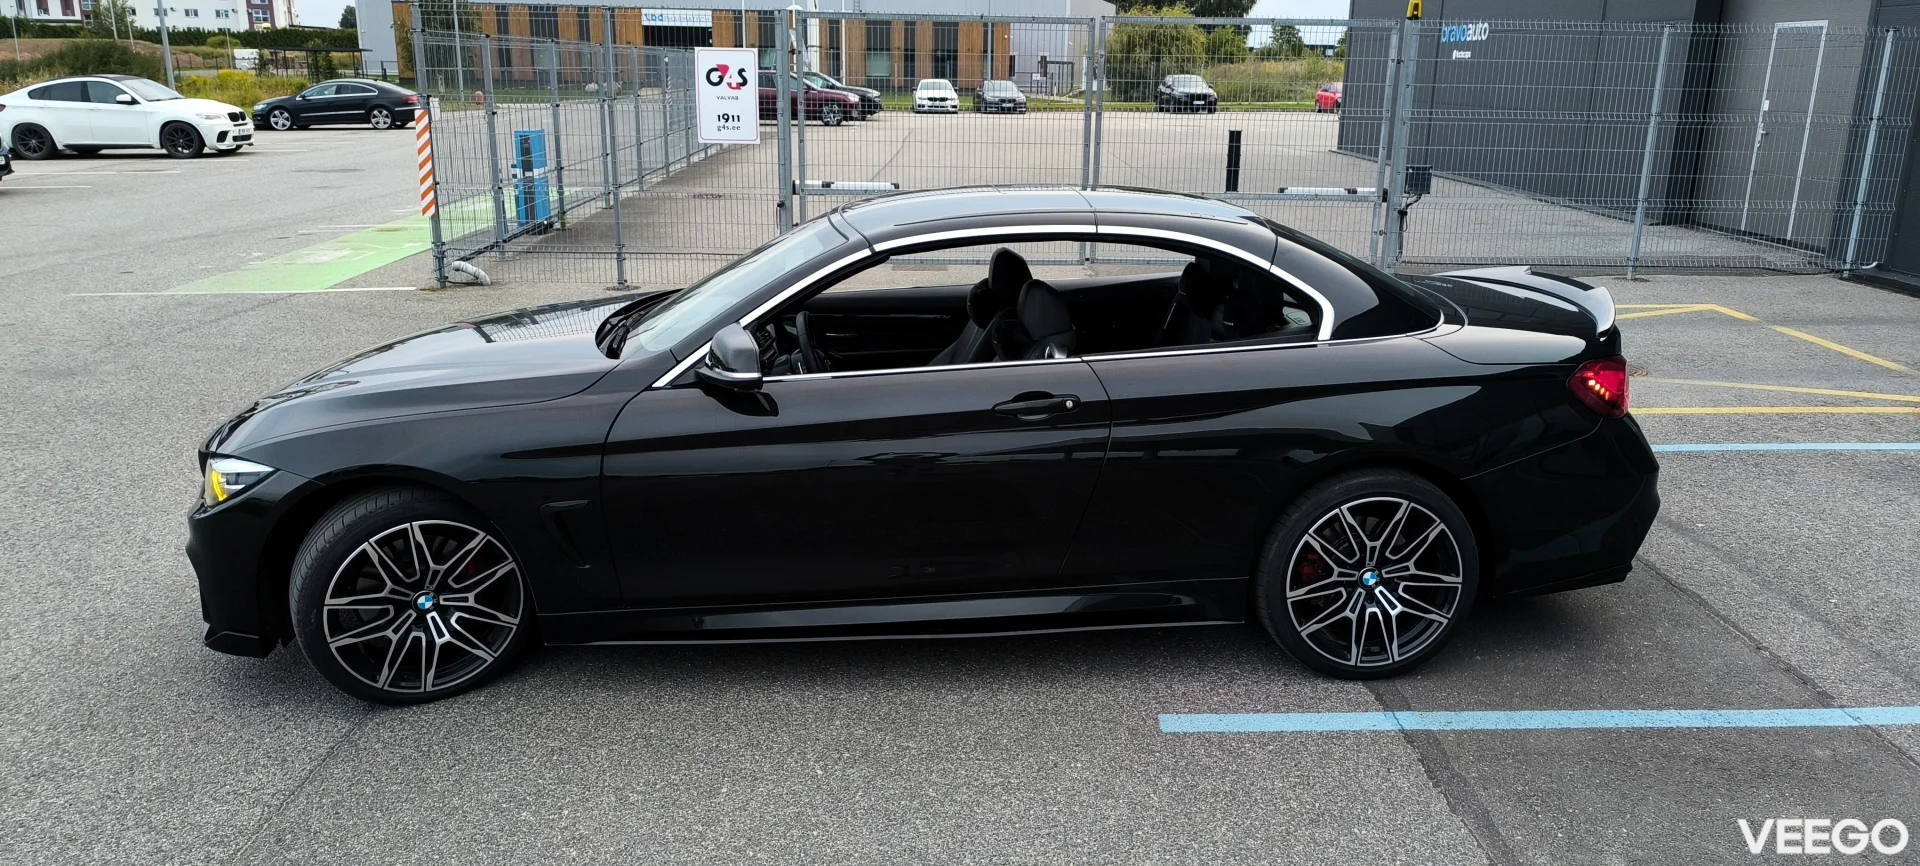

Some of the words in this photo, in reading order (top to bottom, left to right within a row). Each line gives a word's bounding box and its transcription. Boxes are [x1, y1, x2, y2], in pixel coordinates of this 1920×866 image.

[1441, 20, 1489, 42] bravoauto
[706, 64, 748, 90] G4S
[717, 113, 740, 123] 1911
[717, 124, 740, 132] g4s.ee
